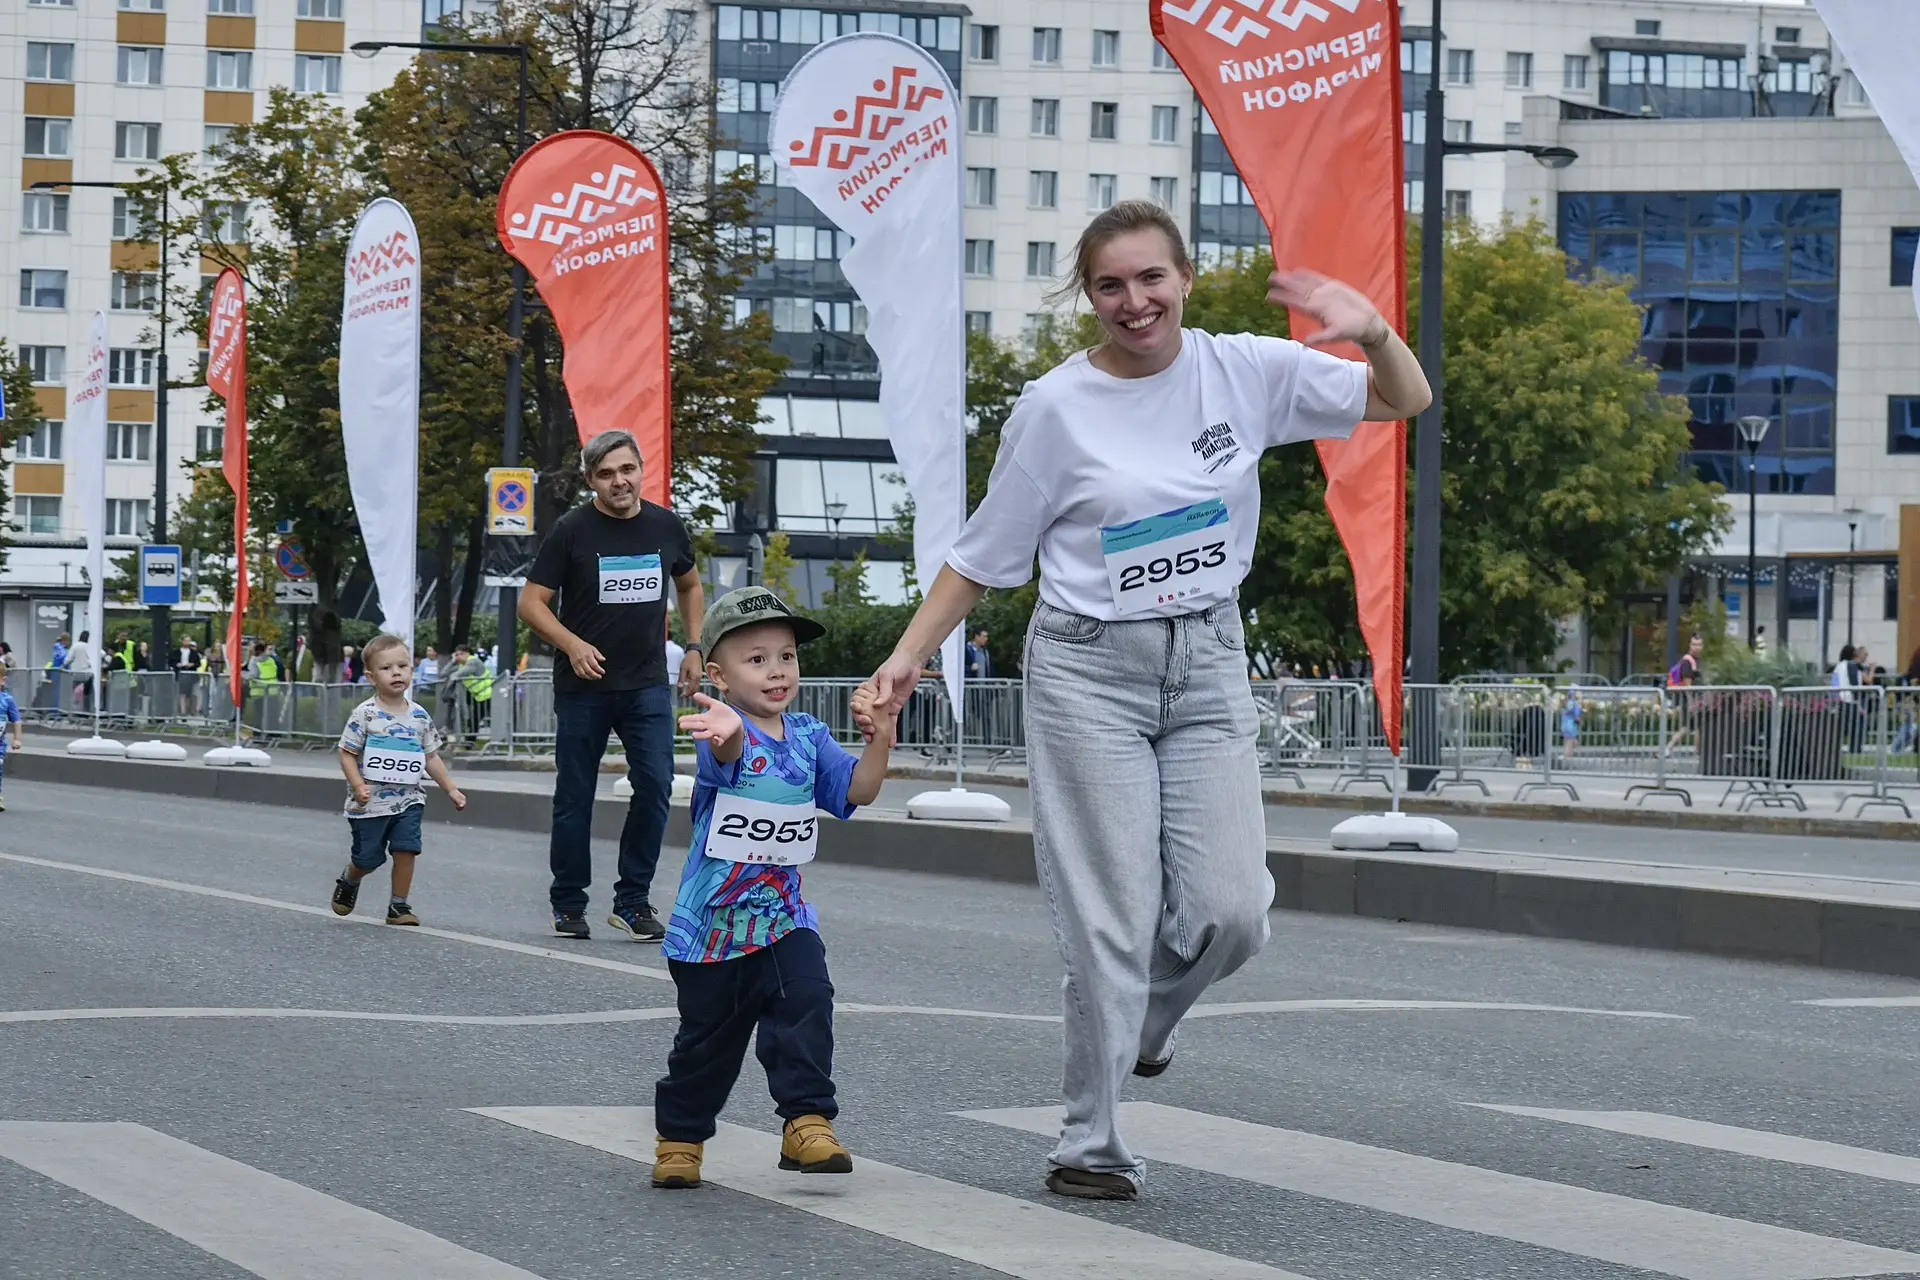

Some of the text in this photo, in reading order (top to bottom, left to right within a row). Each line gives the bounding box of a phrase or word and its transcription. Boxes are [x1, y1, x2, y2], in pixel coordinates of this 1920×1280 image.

[1120, 540, 1227, 592] 2953
[603, 577, 658, 592] 2956
[367, 756, 421, 773] 2956
[717, 813, 815, 843] 2953
